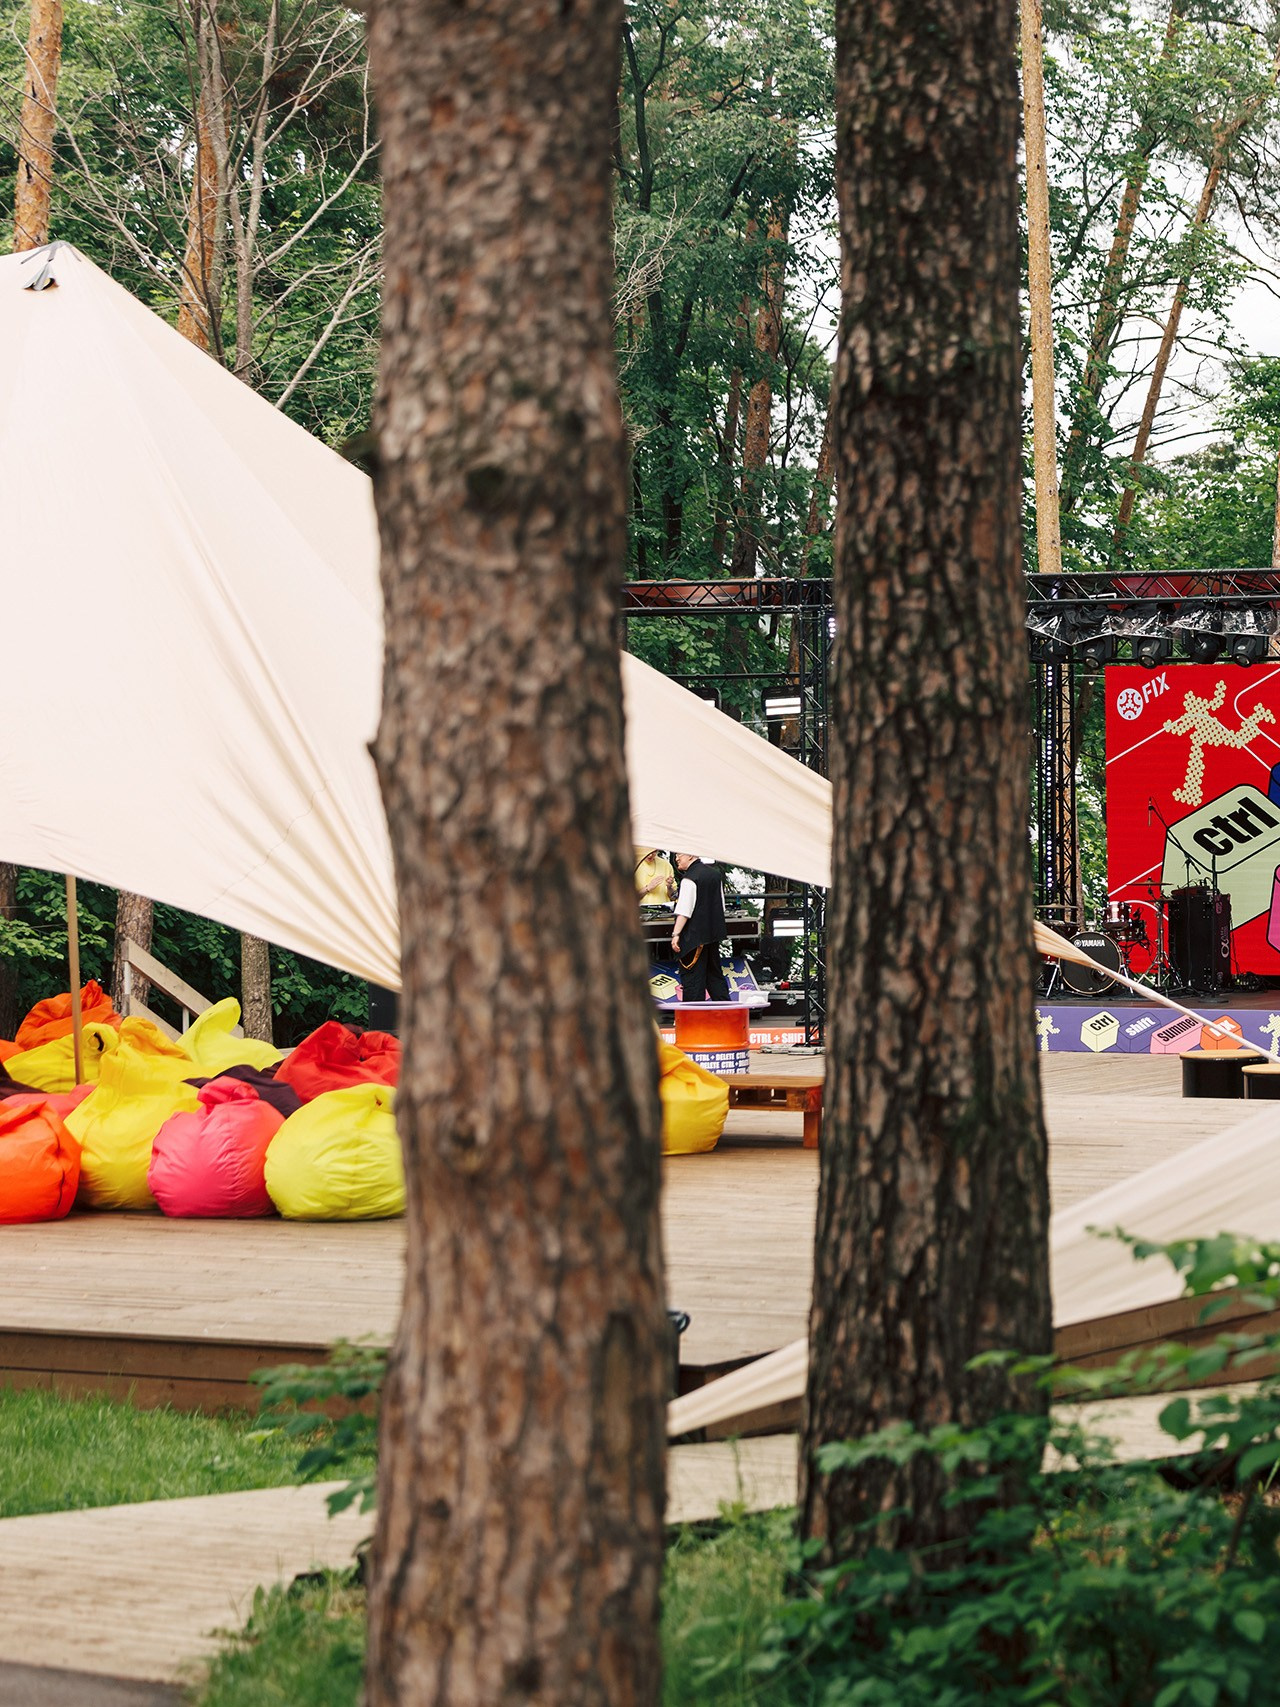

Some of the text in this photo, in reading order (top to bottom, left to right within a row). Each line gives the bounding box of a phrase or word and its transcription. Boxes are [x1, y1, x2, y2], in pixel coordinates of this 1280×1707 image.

[1142, 672, 1170, 704] FIX
[1193, 796, 1280, 856] ctrl
[1081, 939, 1105, 947] YAMAHA
[651, 975, 672, 986] ctrl
[1090, 1015, 1114, 1031] ctrl
[1125, 1016, 1156, 1037] shift
[749, 1033, 773, 1044] CTRL
